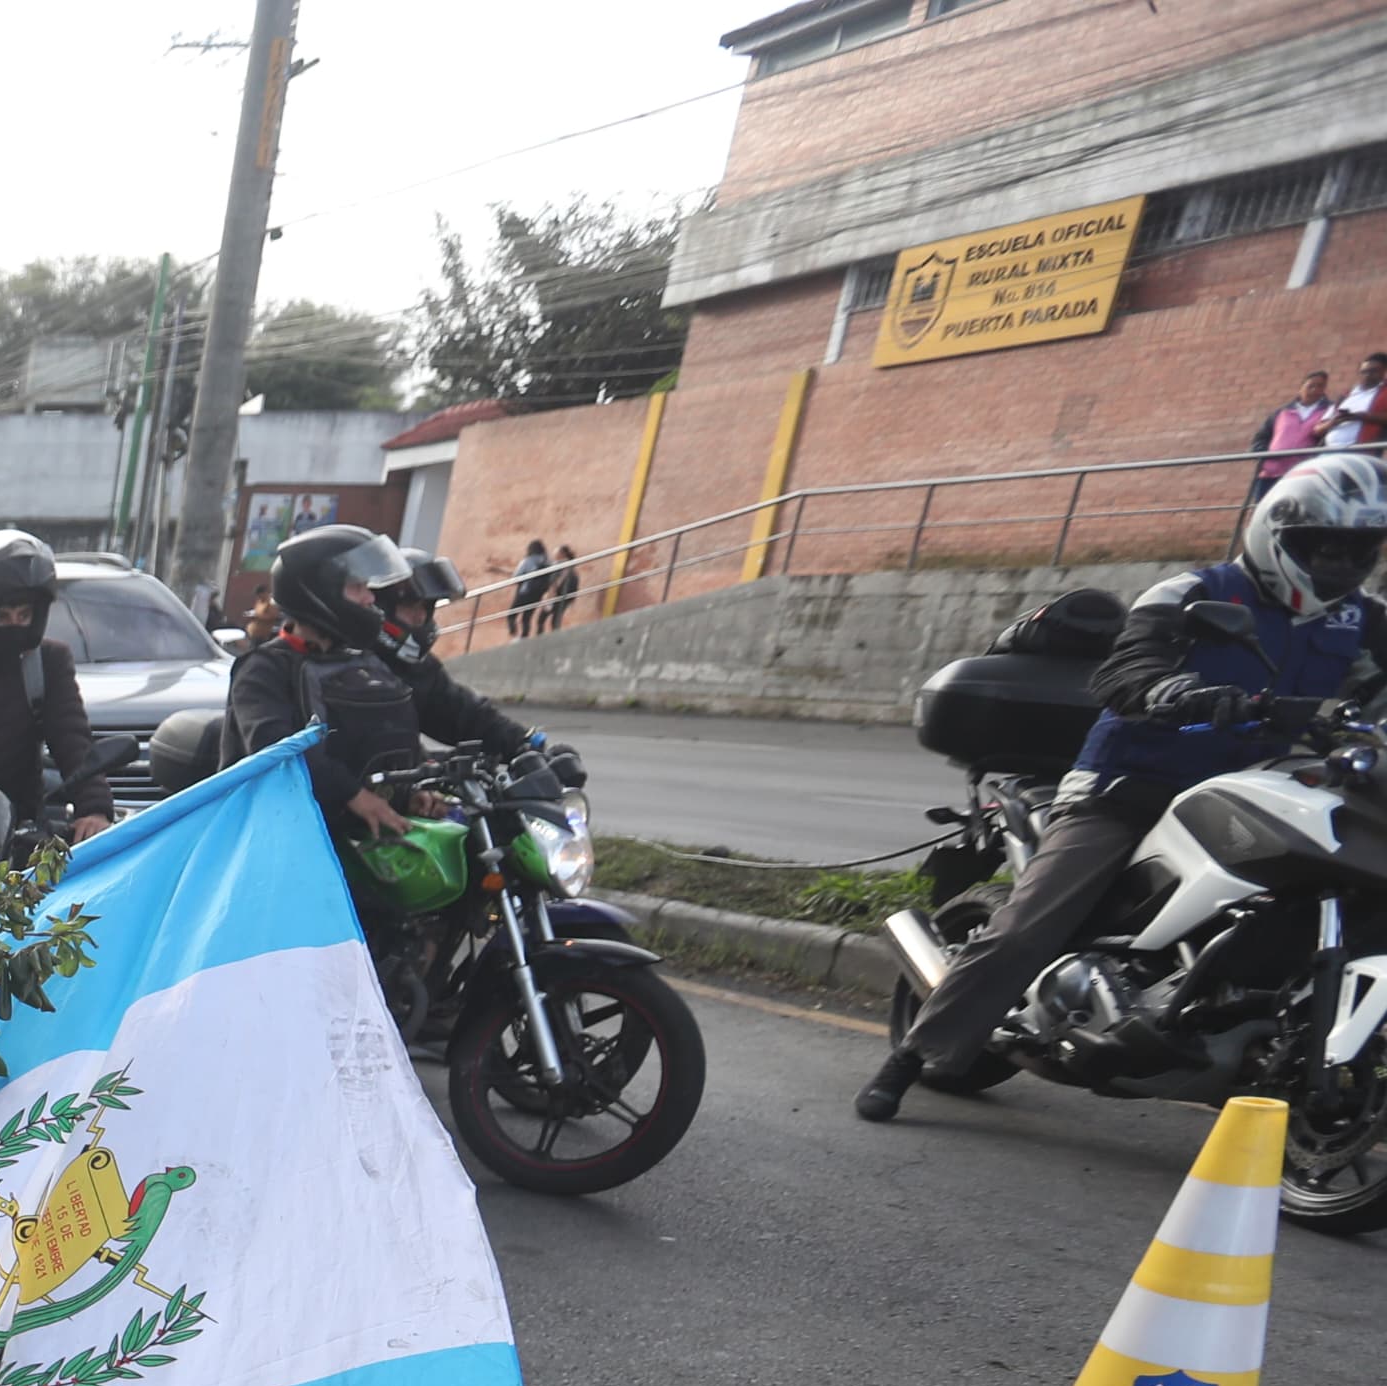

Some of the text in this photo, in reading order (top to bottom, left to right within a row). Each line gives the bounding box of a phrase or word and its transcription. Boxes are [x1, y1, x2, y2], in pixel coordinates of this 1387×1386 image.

[965, 214, 1126, 262] ESCUELA OFICIAL
[968, 248, 1095, 286] RURAL MIXTA
[942, 299, 1098, 340] PUERTA PARADA
[56, 1205, 74, 1242] 15 DE
[66, 1180, 92, 1238] LIBERTAD
[33, 1252, 48, 1280] 1821
